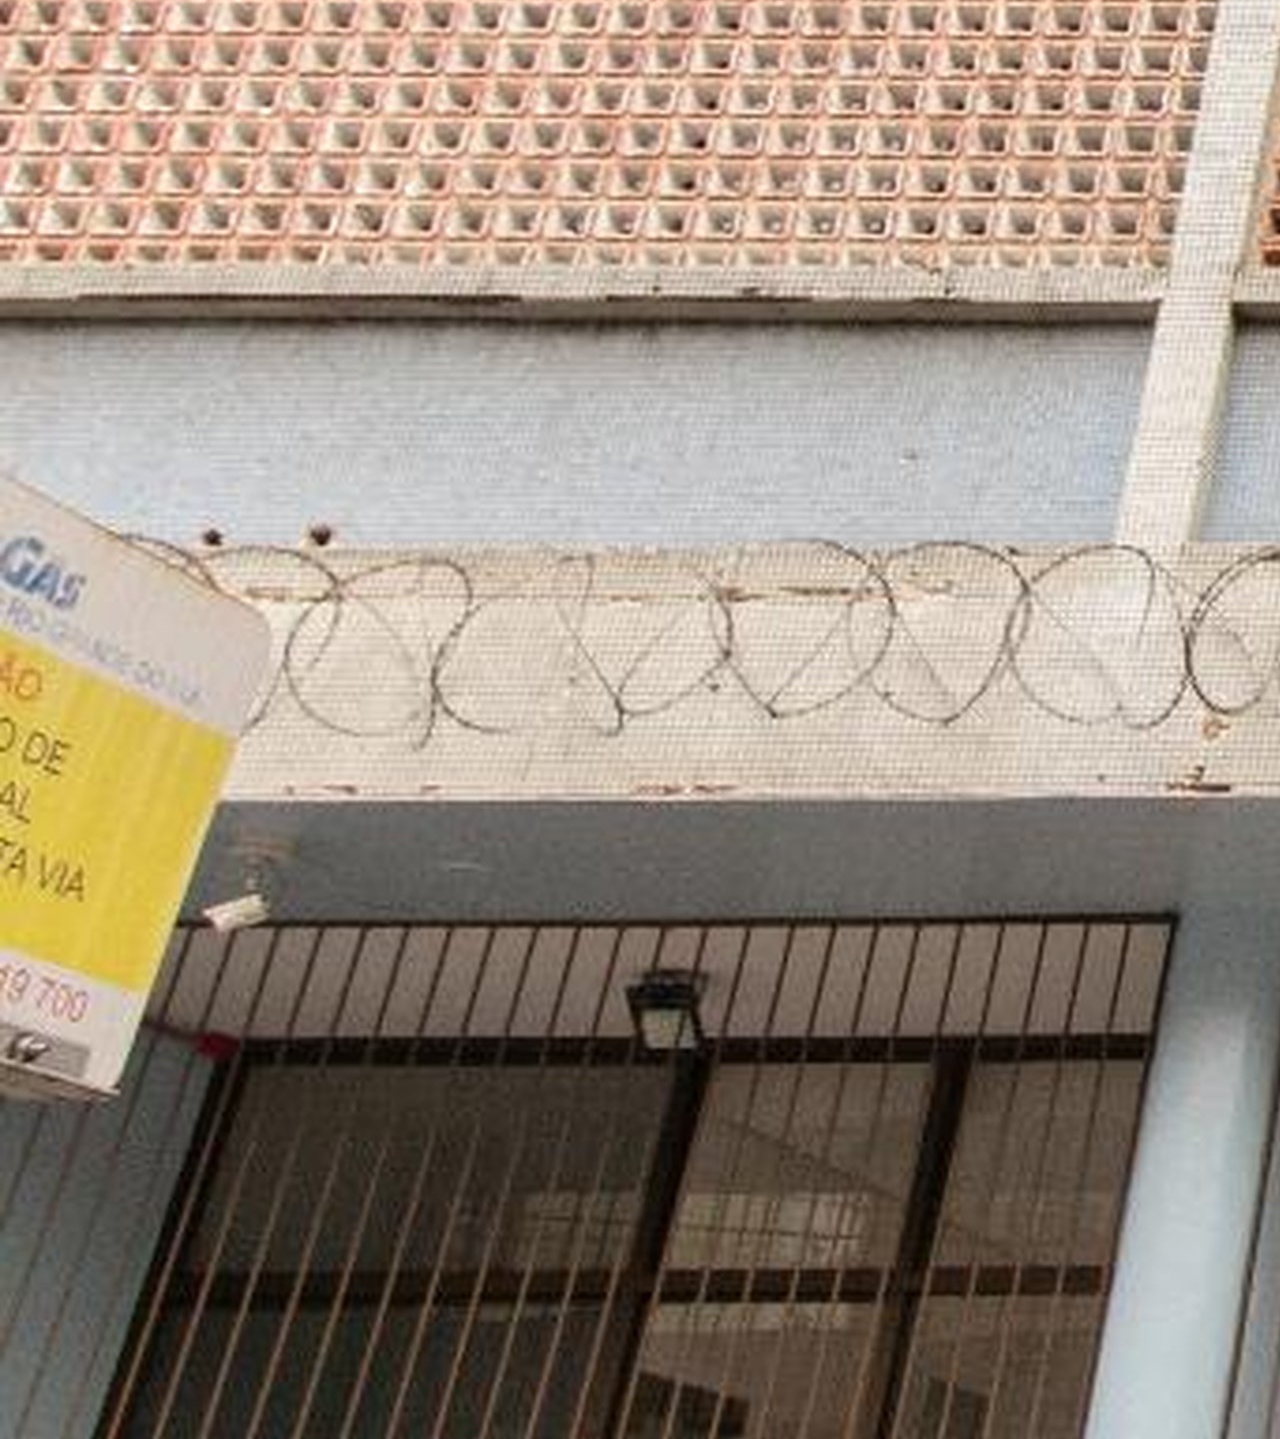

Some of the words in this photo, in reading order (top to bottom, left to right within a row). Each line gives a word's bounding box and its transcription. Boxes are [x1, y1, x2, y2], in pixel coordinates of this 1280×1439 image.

[22, 732, 71, 775] DE
[38, 855, 85, 903] VIA
[34, 975, 88, 1022] 700
